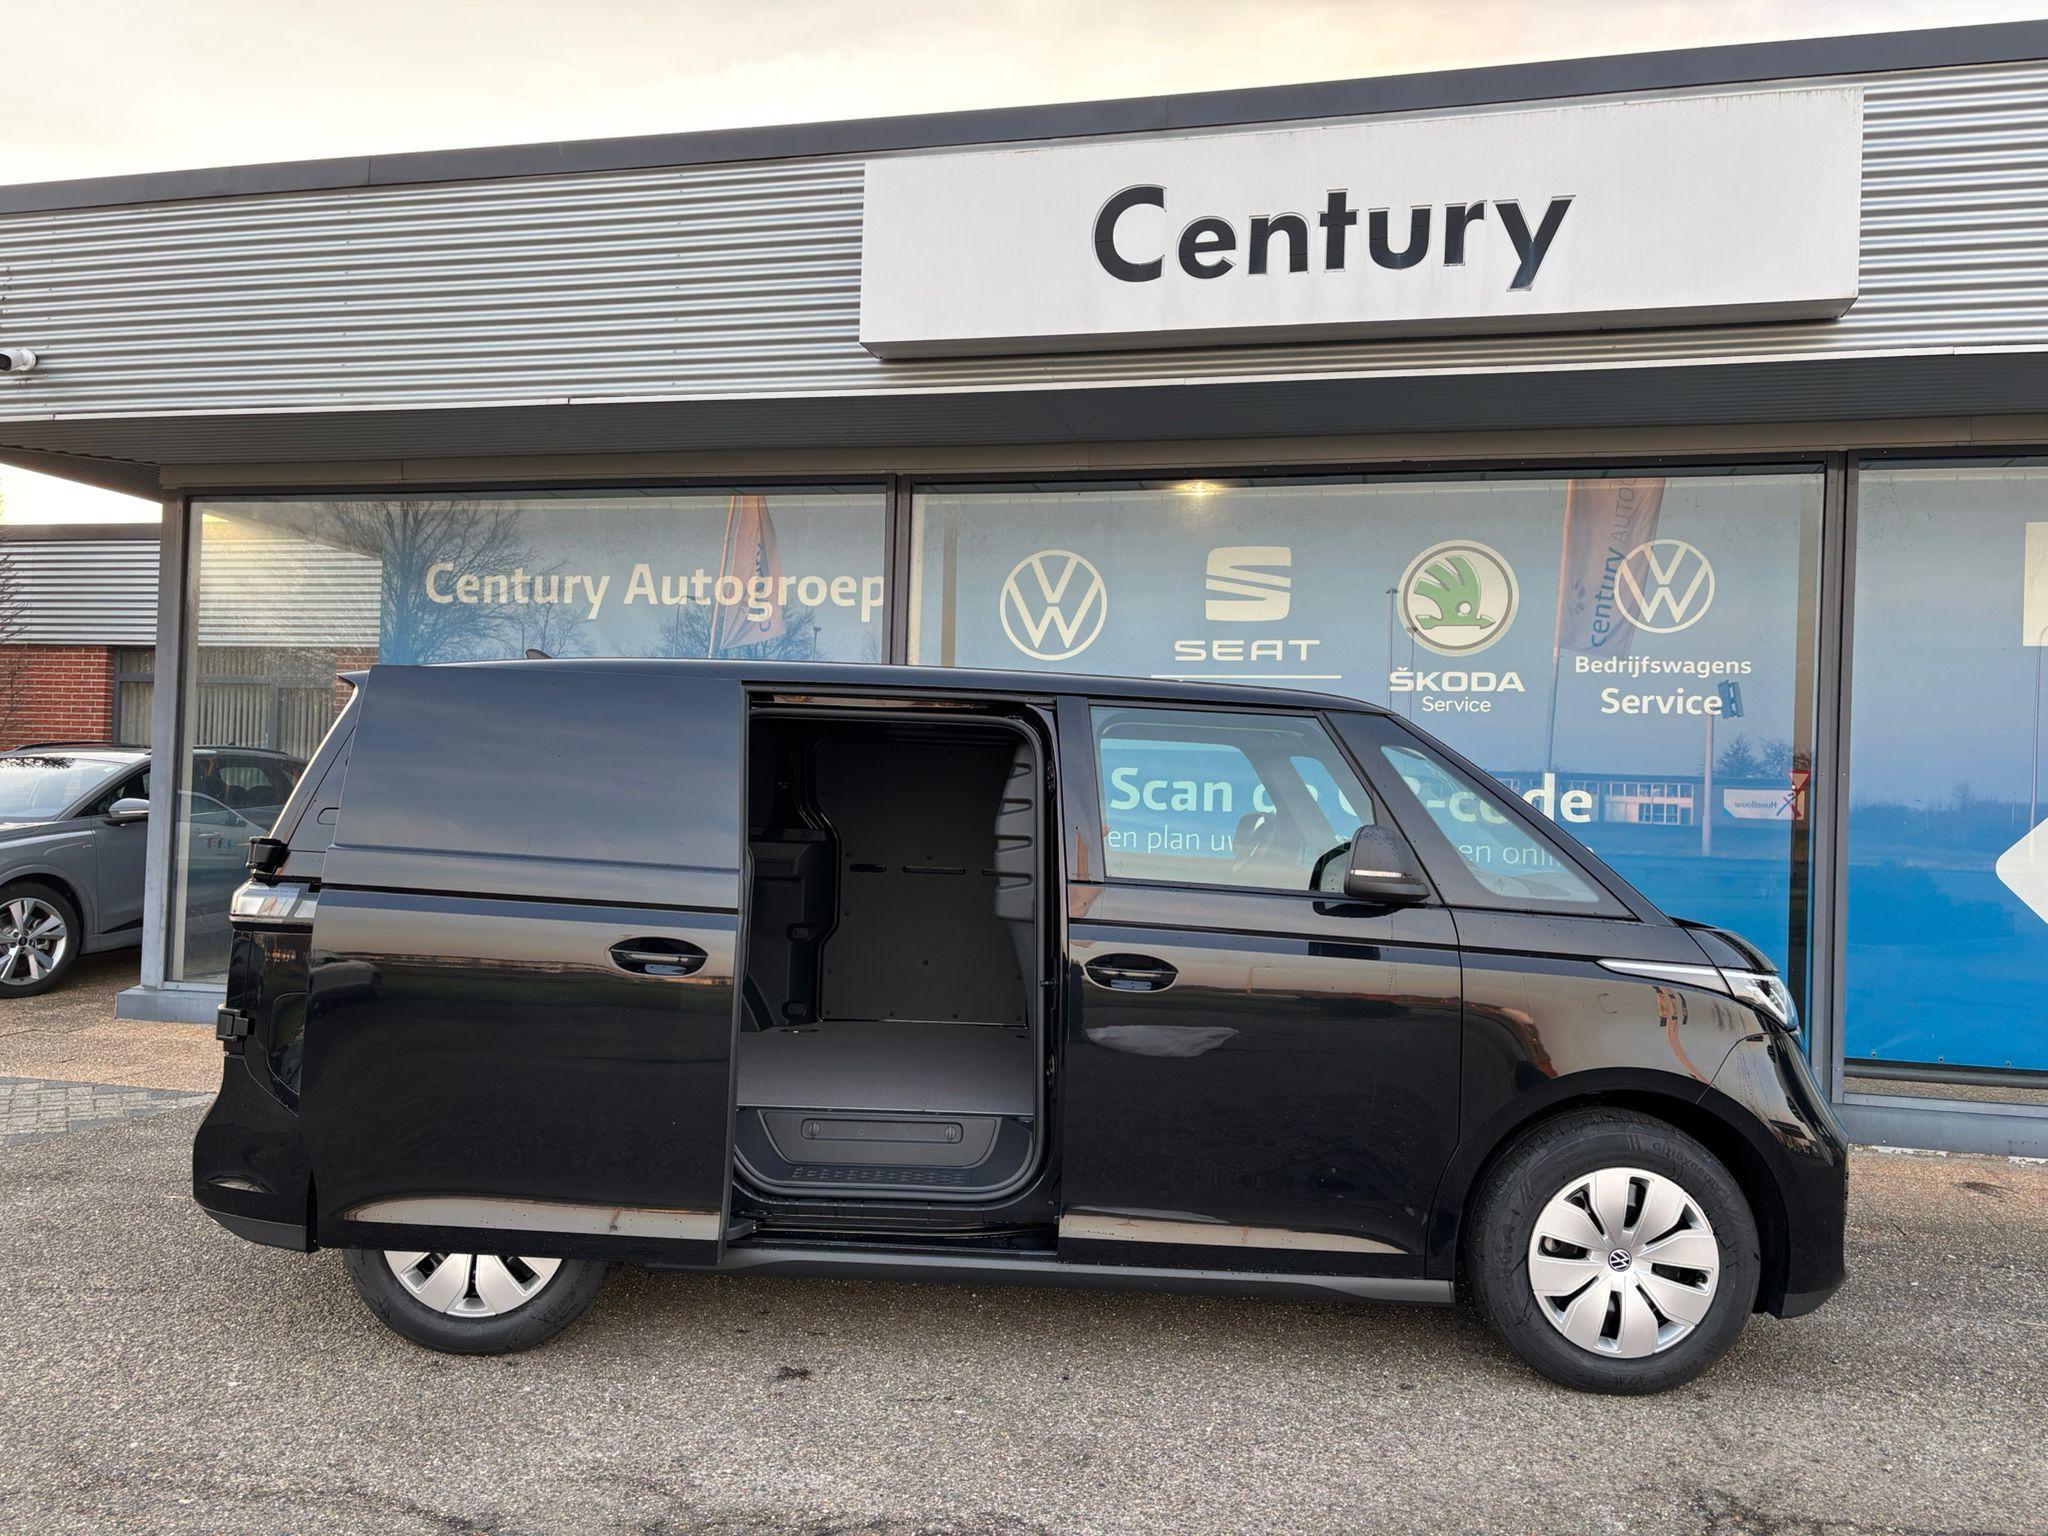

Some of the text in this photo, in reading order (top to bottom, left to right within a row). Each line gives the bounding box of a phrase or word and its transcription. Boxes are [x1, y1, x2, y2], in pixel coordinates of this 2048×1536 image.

[1092, 183, 1576, 292] Century
[425, 562, 610, 620] Century
[623, 562, 885, 622] Autogroep
[1174, 639, 1321, 662] SEAT
[1389, 667, 1526, 693] ŠKODA
[1575, 655, 1752, 679] Bedrijfswagens
[1422, 695, 1492, 713] Service
[1601, 688, 1723, 716] Service
[1110, 767, 1232, 812] Scan
[1108, 830, 1137, 849] en
[1147, 825, 1200, 853] plan
